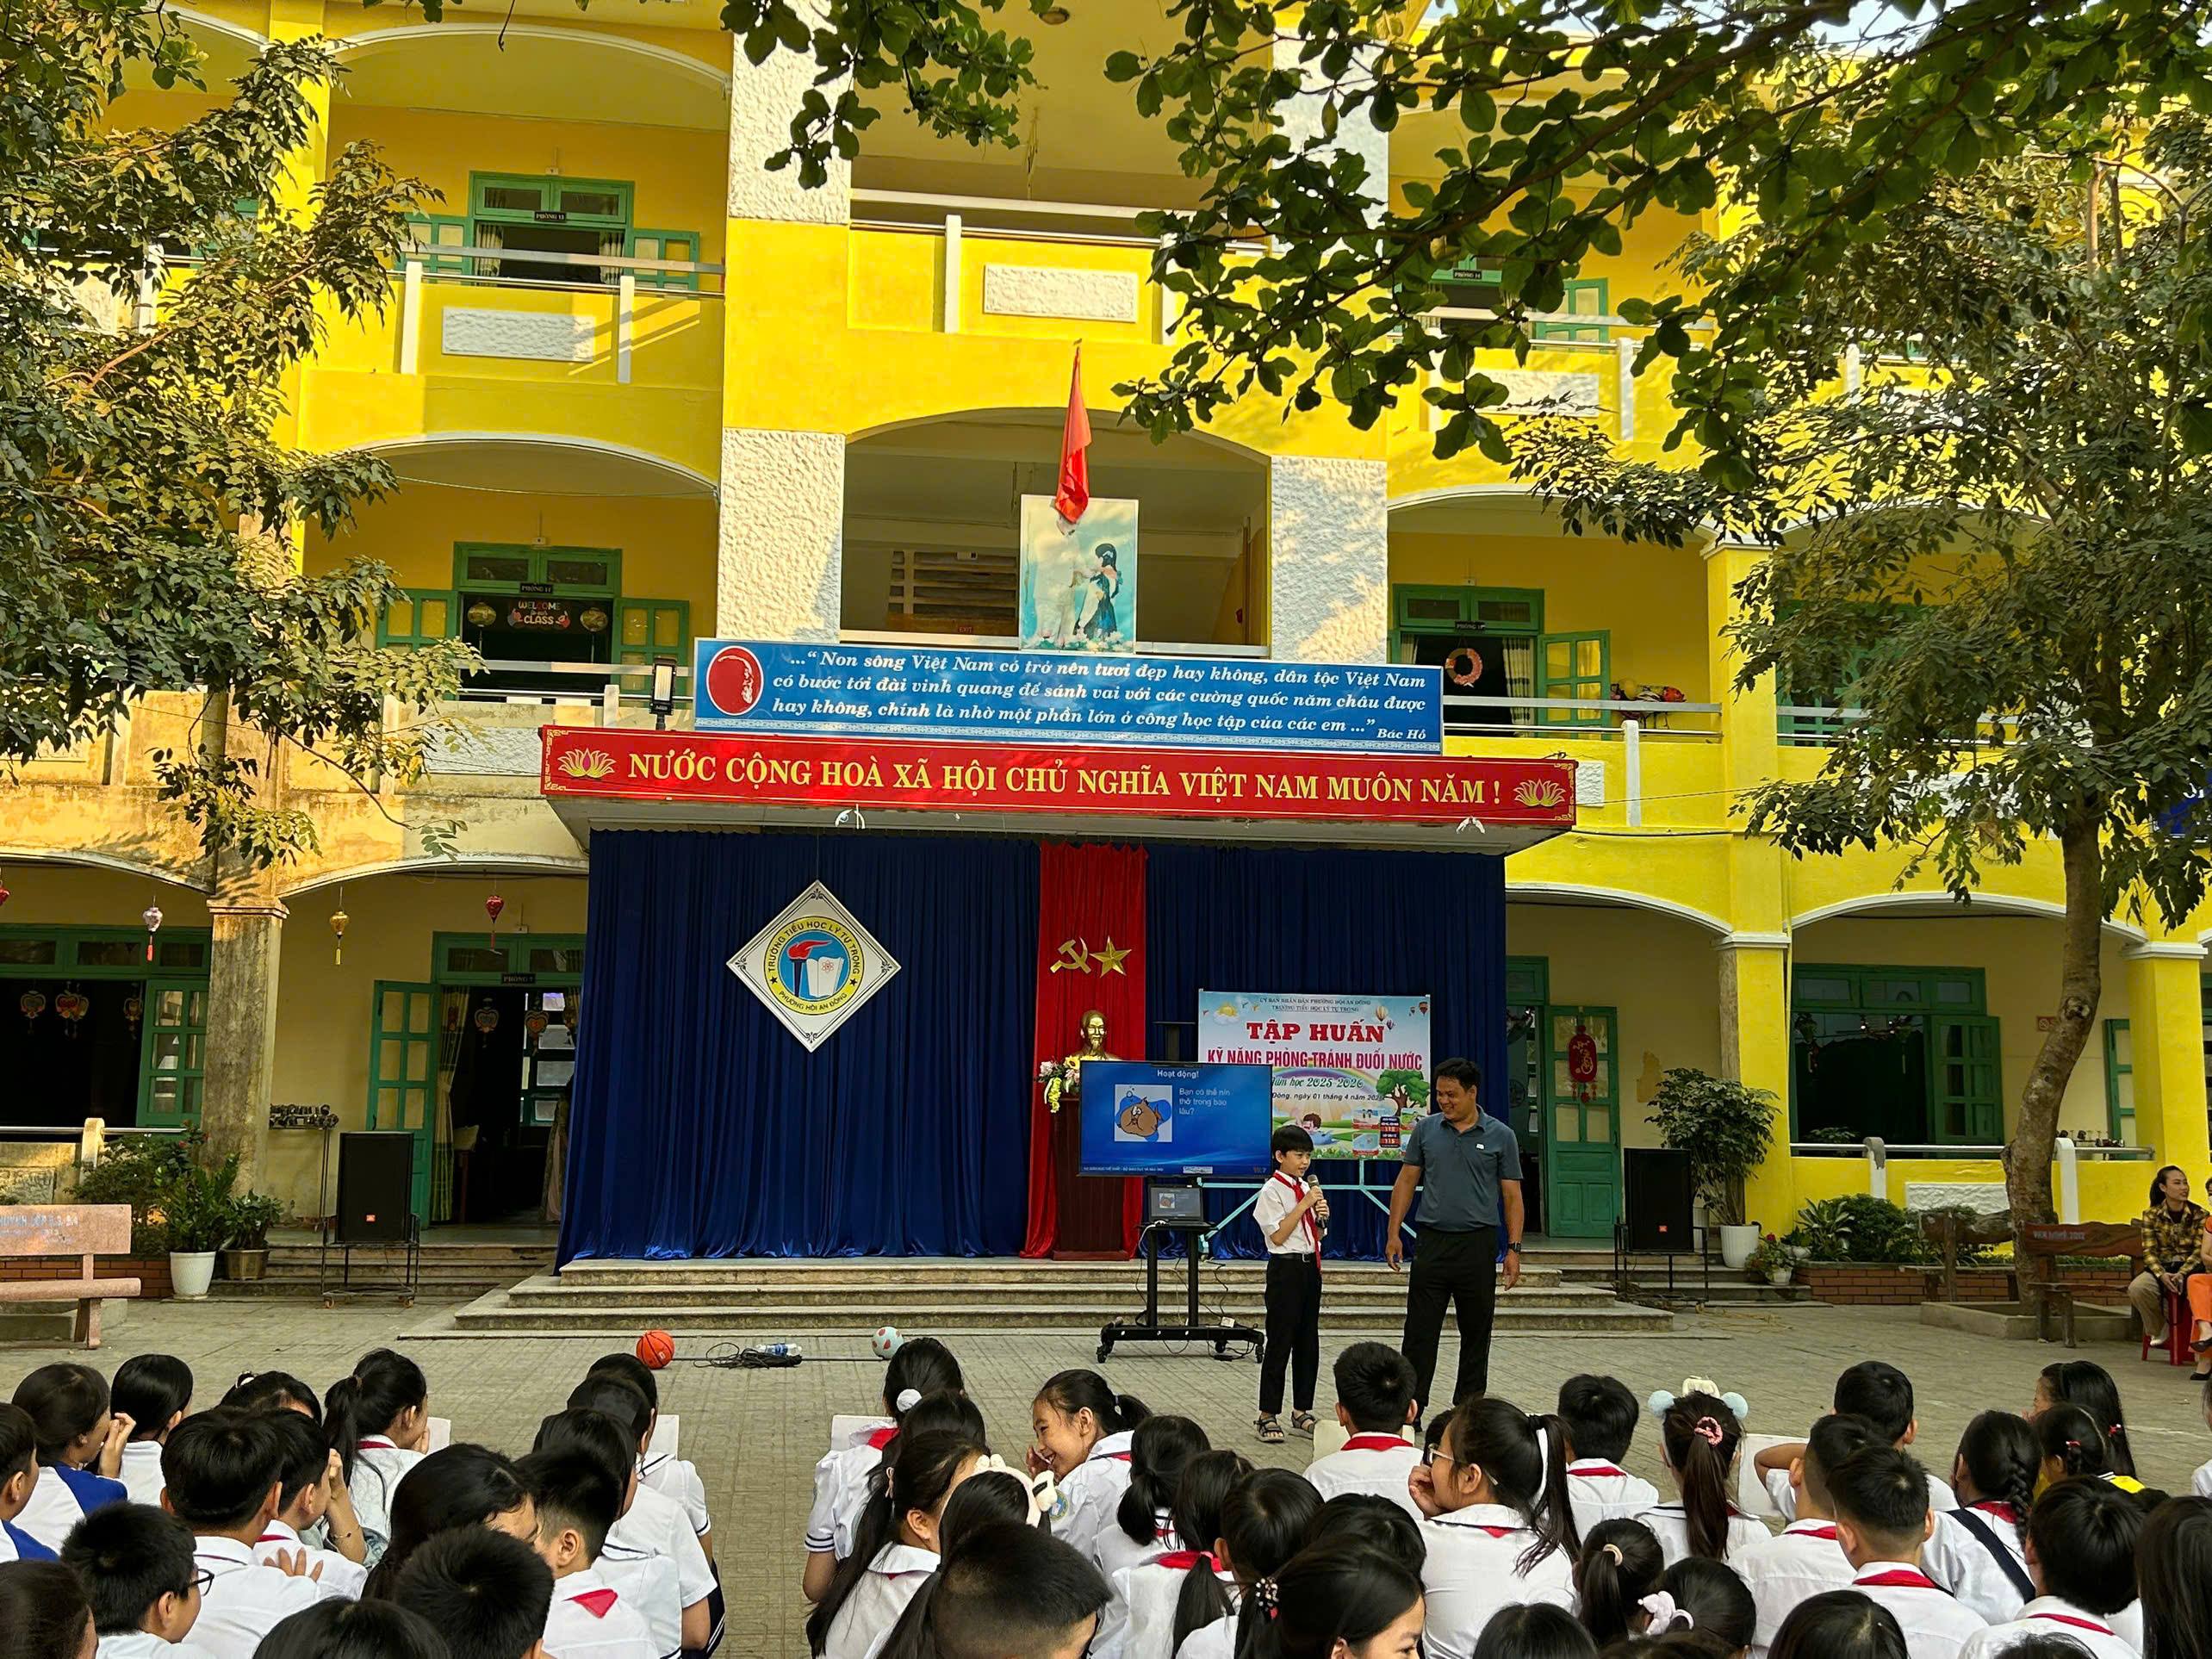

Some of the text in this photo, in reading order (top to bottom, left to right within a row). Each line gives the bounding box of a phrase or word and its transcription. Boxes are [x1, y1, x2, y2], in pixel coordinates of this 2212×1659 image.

[519, 600, 561, 610] WELCOME
[524, 615, 554, 624] CLASS
[822, 652, 858, 667] Non
[864, 653, 905, 672] sông
[911, 654, 948, 671] Việt
[953, 656, 993, 672] Nam
[1000, 657, 1019, 672] có
[1025, 657, 1053, 674] trở
[1057, 661, 1089, 676] nên
[1095, 662, 1130, 678] tươi
[1136, 662, 1166, 682] đẹp
[1173, 665, 1204, 682] hay
[1210, 667, 1268, 686] không,
[1275, 668, 1307, 684] dân
[1314, 670, 1339, 687] tộc
[1345, 670, 1379, 688] Việt
[1384, 673, 1426, 688] Nam
[774, 674, 793, 687] có
[799, 674, 842, 689] bước
[847, 675, 871, 690] tới
[876, 676, 908, 692] đài
[912, 677, 951, 693] vinh
[957, 683, 1014, 699] quang
[1044, 683, 1087, 699] sánh
[1092, 686, 1119, 700] vai
[1125, 687, 1150, 702] với
[1156, 687, 1185, 703] các
[1190, 688, 1241, 706] cường
[1247, 688, 1289, 708] quốc
[1293, 693, 1333, 709] năm
[1336, 693, 1378, 710] châu
[1384, 696, 1426, 712] được
[773, 698, 806, 714] hay
[811, 699, 872, 718] không,
[878, 701, 929, 718] chính
[936, 702, 953, 718] là
[959, 704, 994, 720] nhờ
[998, 706, 1031, 723] một
[1035, 707, 1083, 724] phần
[1088, 709, 1115, 724] lớn
[1121, 710, 1133, 725] ở
[1136, 711, 1177, 729] công
[1182, 711, 1212, 730] học
[1217, 714, 1246, 731] tập
[1288, 717, 1316, 731] các
[1320, 720, 1346, 732] em
[1377, 728, 1402, 739] Bác
[628, 748, 716, 781] NƯỚC
[726, 752, 811, 790] CỘNG
[821, 754, 884, 788] HOÀ
[893, 758, 932, 789] XÃ
[942, 760, 996, 797] HỘI
[1005, 758, 1066, 794] CHỦ
[1078, 764, 1171, 796] NGHĨA
[1178, 767, 1247, 806] VIỆT
[1254, 774, 1319, 801] NAM
[1327, 771, 1412, 803] MUÔN
[1420, 772, 1485, 804] NĂM
[1246, 1019, 1385, 1044] TẬP HUẤN
[1208, 1047, 1224, 1063] KỸ
[1227, 1047, 1262, 1064] NĂNG
[1356, 1047, 1384, 1070] ĐUỐI
[1389, 1051, 1424, 1071] NƯỚC
[1157, 1069, 1199, 1079] Hoạt động!
[1289, 1077, 1304, 1087] học
[1179, 1087, 1194, 1097] Bạn
[1206, 1087, 1217, 1096] thể
[1322, 1093, 1343, 1102] tháng
[1193, 1098, 1212, 1108] trong
[1178, 1107, 1196, 1115] lâu?
